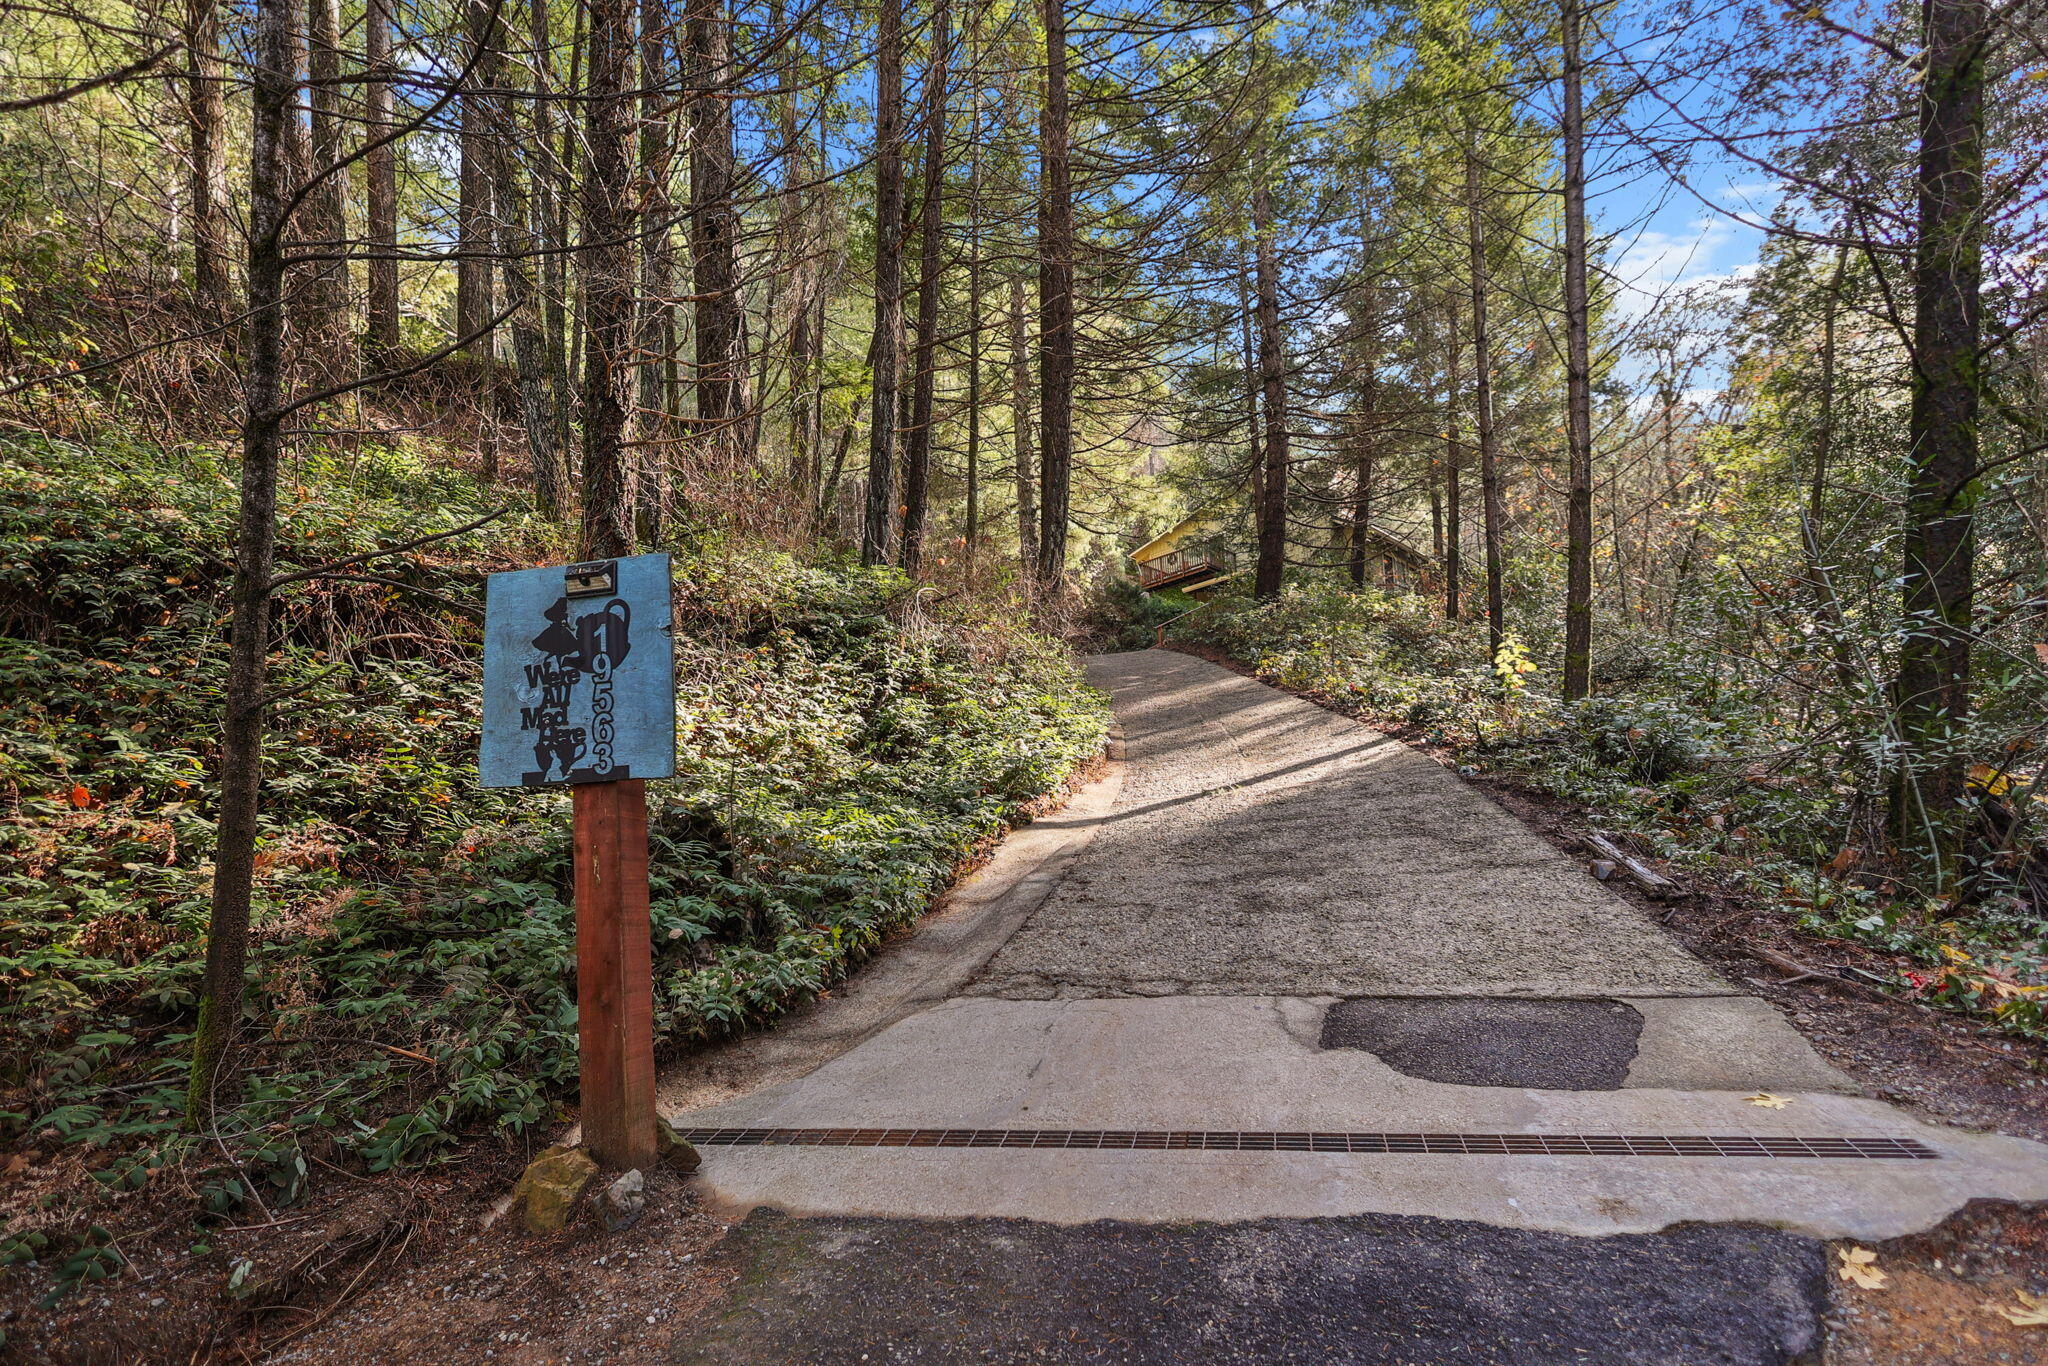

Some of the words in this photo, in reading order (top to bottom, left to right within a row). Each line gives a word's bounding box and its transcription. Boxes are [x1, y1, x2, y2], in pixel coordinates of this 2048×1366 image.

[541, 684, 572, 708] All
[592, 623, 615, 775] 19563
[520, 704, 570, 731] Mad
[538, 726, 587, 746] Here
